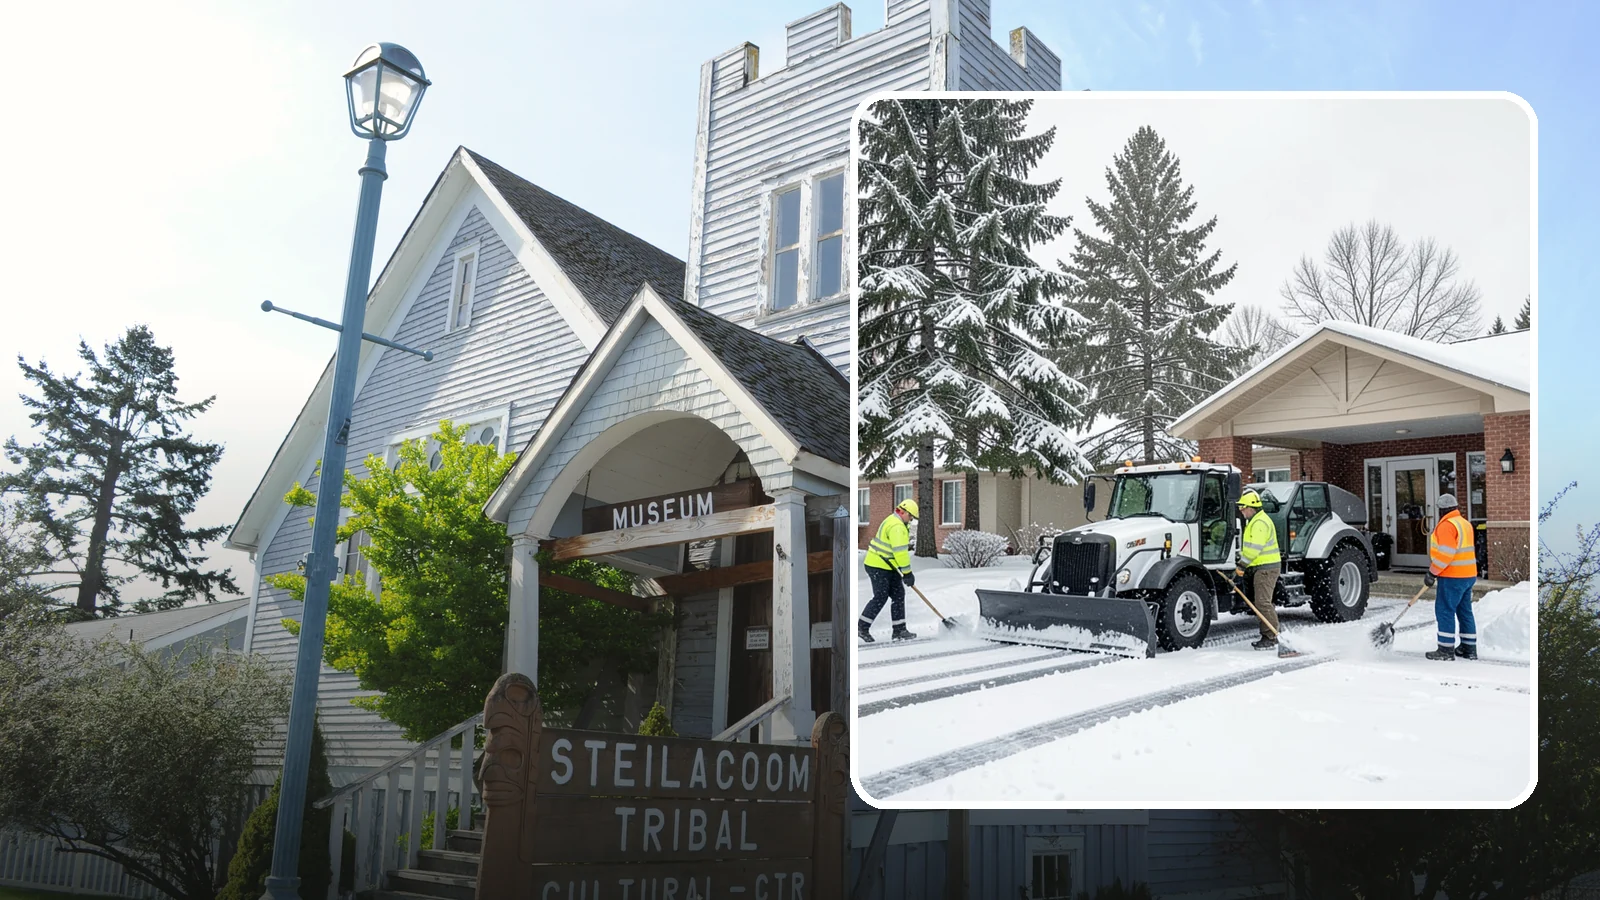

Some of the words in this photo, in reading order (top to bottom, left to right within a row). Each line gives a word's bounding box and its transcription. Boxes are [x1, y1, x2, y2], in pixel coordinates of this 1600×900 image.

[612, 491, 714, 531] MUSEUM
[550, 738, 809, 792] STEILACOOM
[614, 806, 757, 851] TRIBAL
